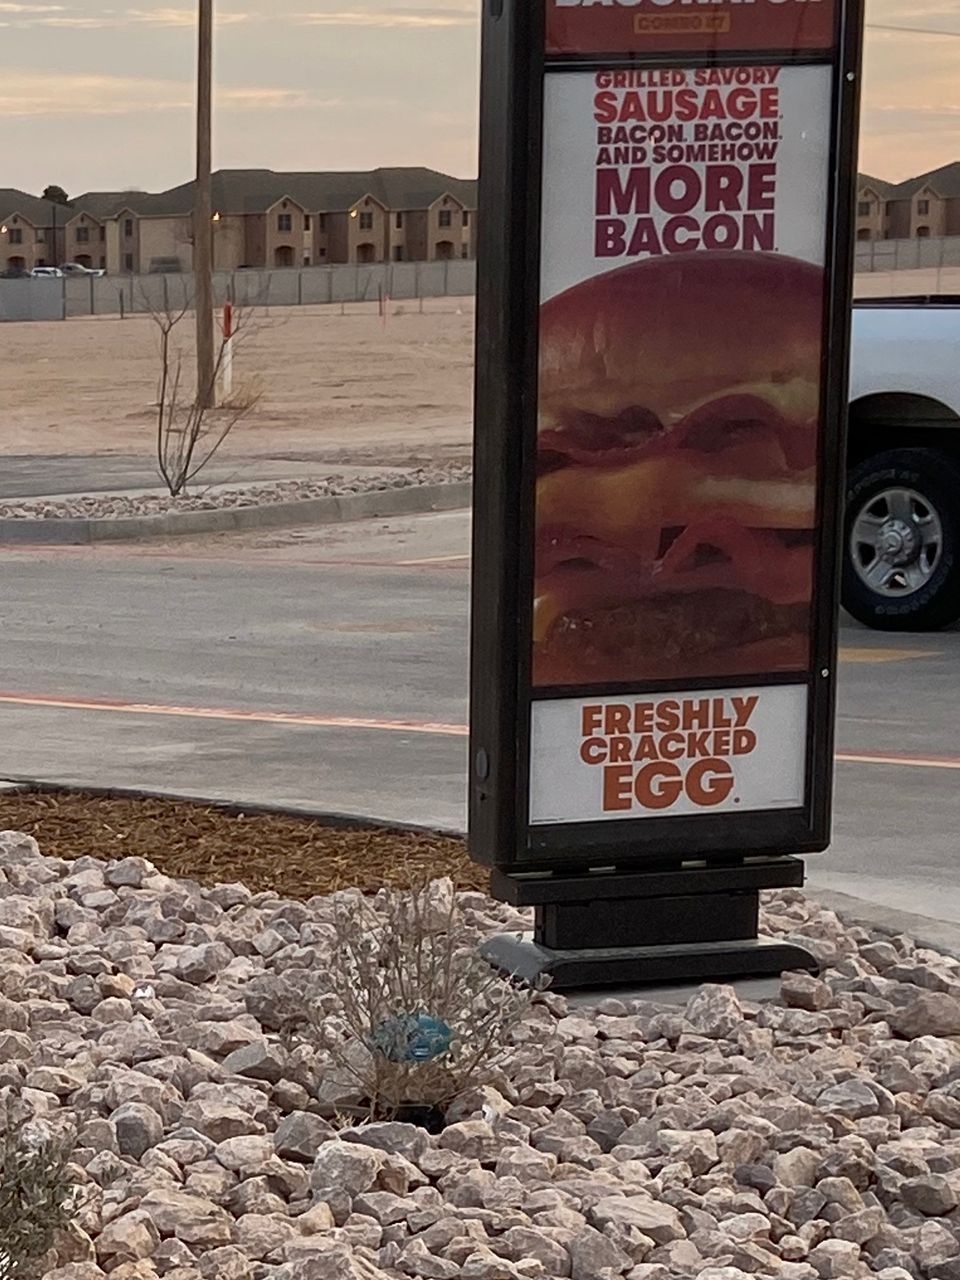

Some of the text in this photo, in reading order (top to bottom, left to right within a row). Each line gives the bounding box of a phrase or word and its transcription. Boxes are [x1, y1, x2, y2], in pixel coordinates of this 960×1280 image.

[694, 66, 782, 87] SAVORY
[597, 121, 784, 145] BACON. BACON.
[596, 142, 780, 166] AND SOMEHOW
[595, 162, 778, 216] MORE
[594, 213, 780, 258] BACON.
[581, 695, 760, 737] FRESHLY
[579, 728, 757, 766] CRACKED
[602, 757, 741, 812] EGG.
